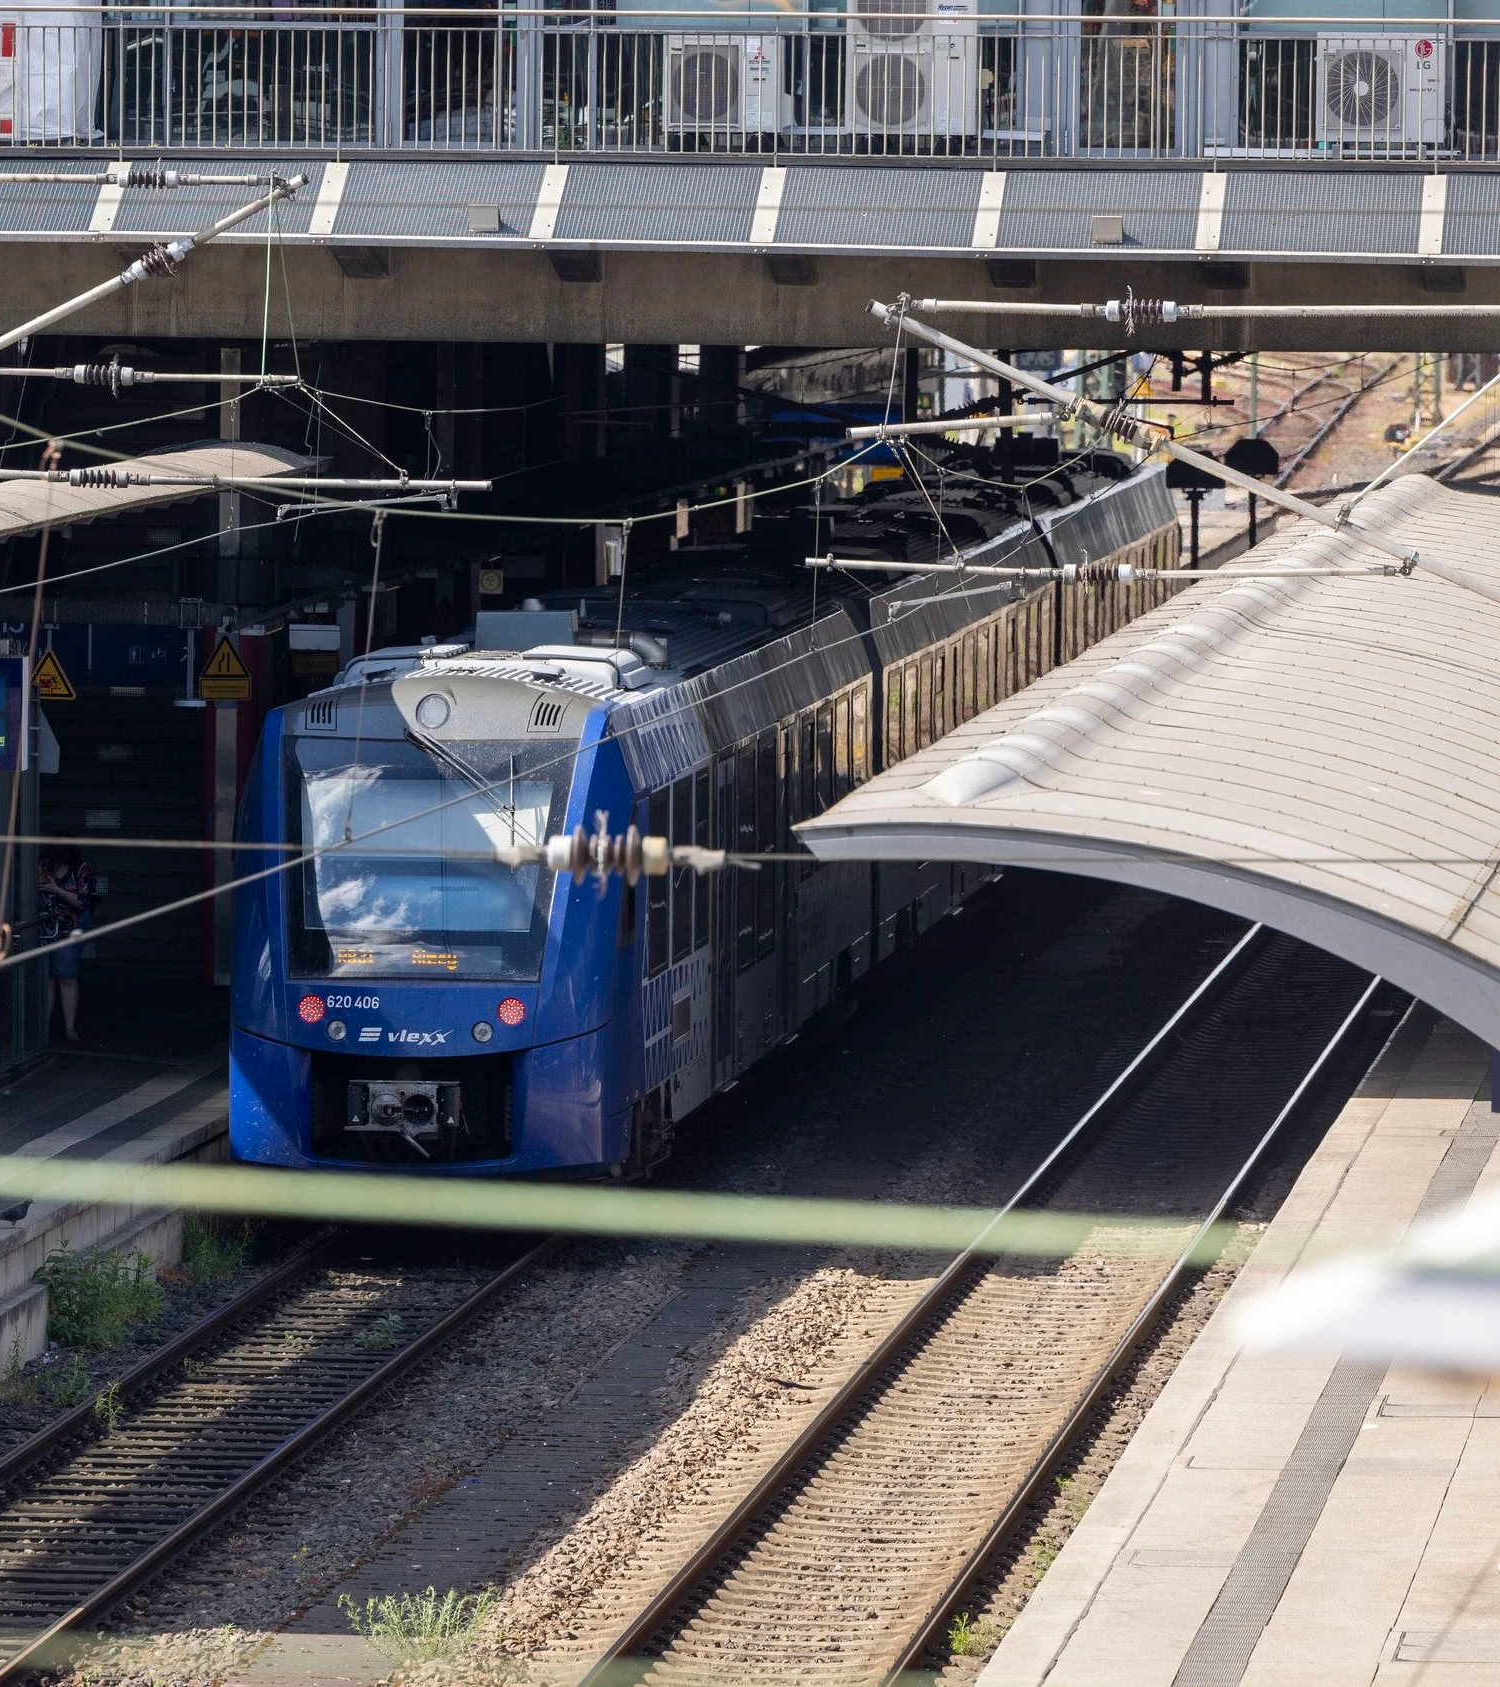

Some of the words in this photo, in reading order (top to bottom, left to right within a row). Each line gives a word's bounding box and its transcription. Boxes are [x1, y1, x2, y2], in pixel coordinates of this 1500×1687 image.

[1417, 61, 1431, 69] LG
[327, 995, 351, 1008] 620
[354, 996, 380, 1009] 406
[388, 1029, 454, 1045] vlexx
